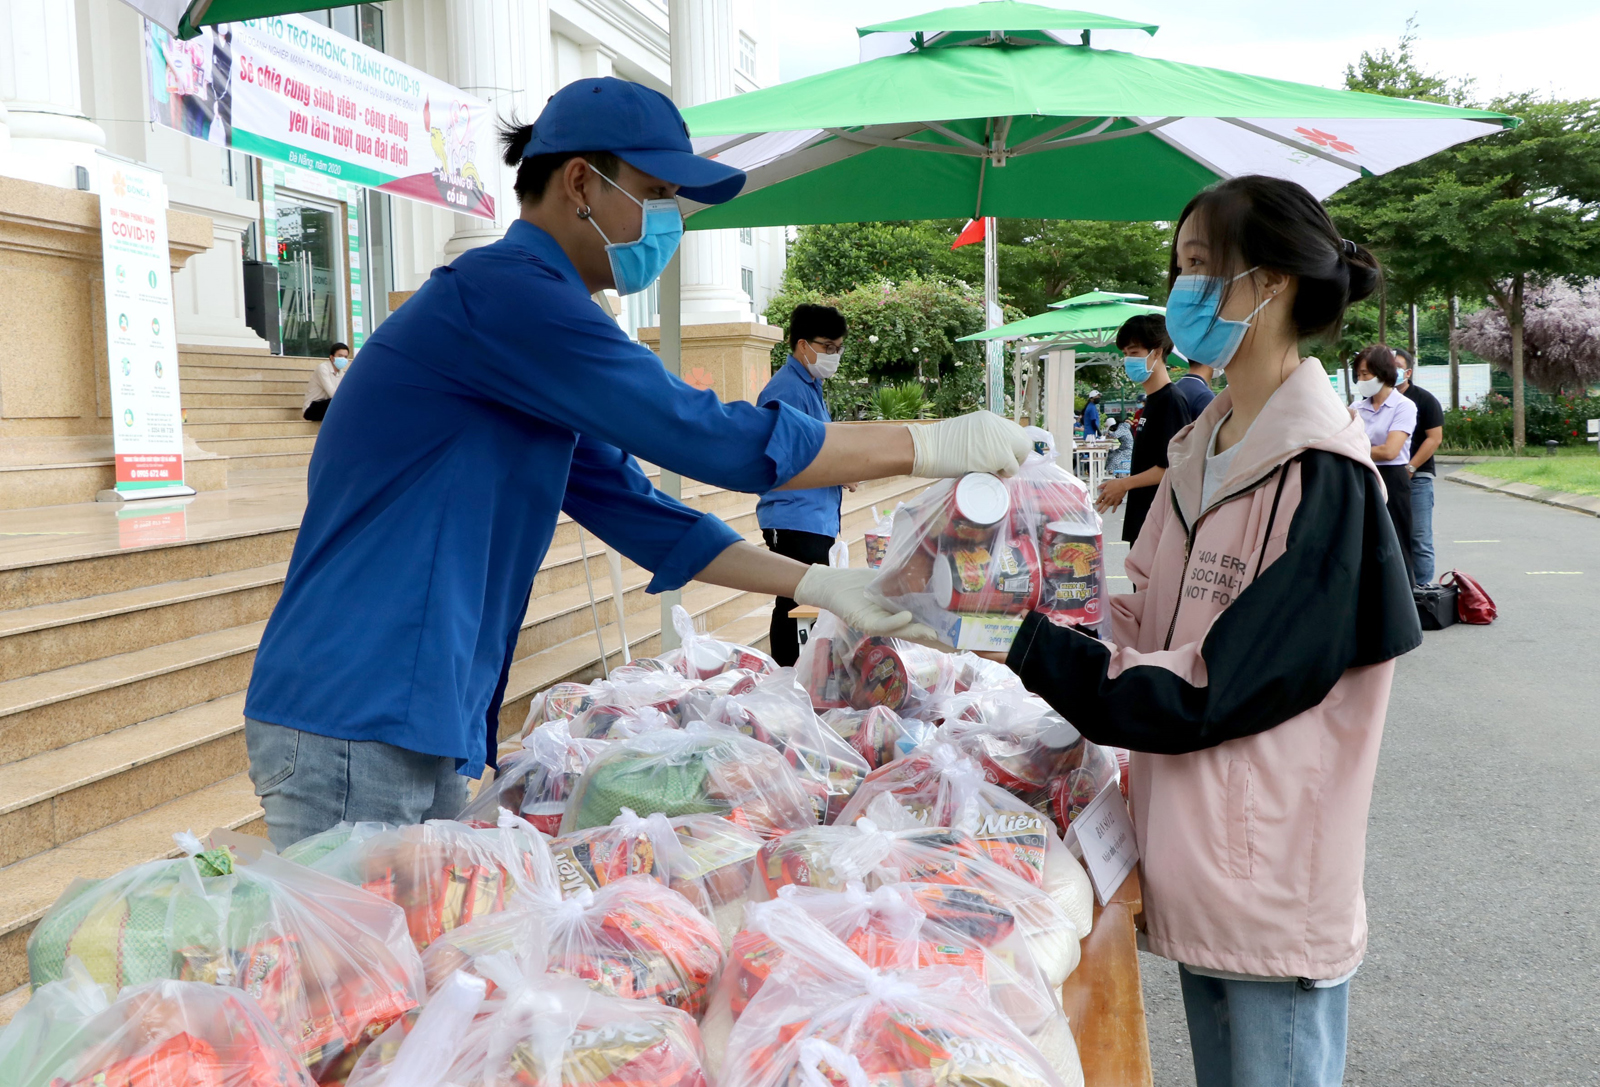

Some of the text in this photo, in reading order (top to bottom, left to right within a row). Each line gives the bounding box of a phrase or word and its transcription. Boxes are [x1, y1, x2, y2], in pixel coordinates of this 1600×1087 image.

[287, 24, 308, 52] TRỢ
[351, 52, 381, 82] TRÁNH
[383, 67, 420, 97] COVID-19
[240, 55, 254, 83] Sẻ
[257, 64, 282, 93] chia
[284, 76, 311, 106] cùng
[313, 86, 334, 113] sinh
[337, 95, 356, 121] viên
[365, 106, 386, 134] cộng
[388, 112, 408, 142] đồng
[289, 109, 408, 167] yên tâm vượt qua đại dịch
[315, 159, 327, 172] năm
[328, 162, 342, 175] 2020
[112, 221, 155, 243] COVID-19
[1185, 585, 1236, 606] NOT FO
